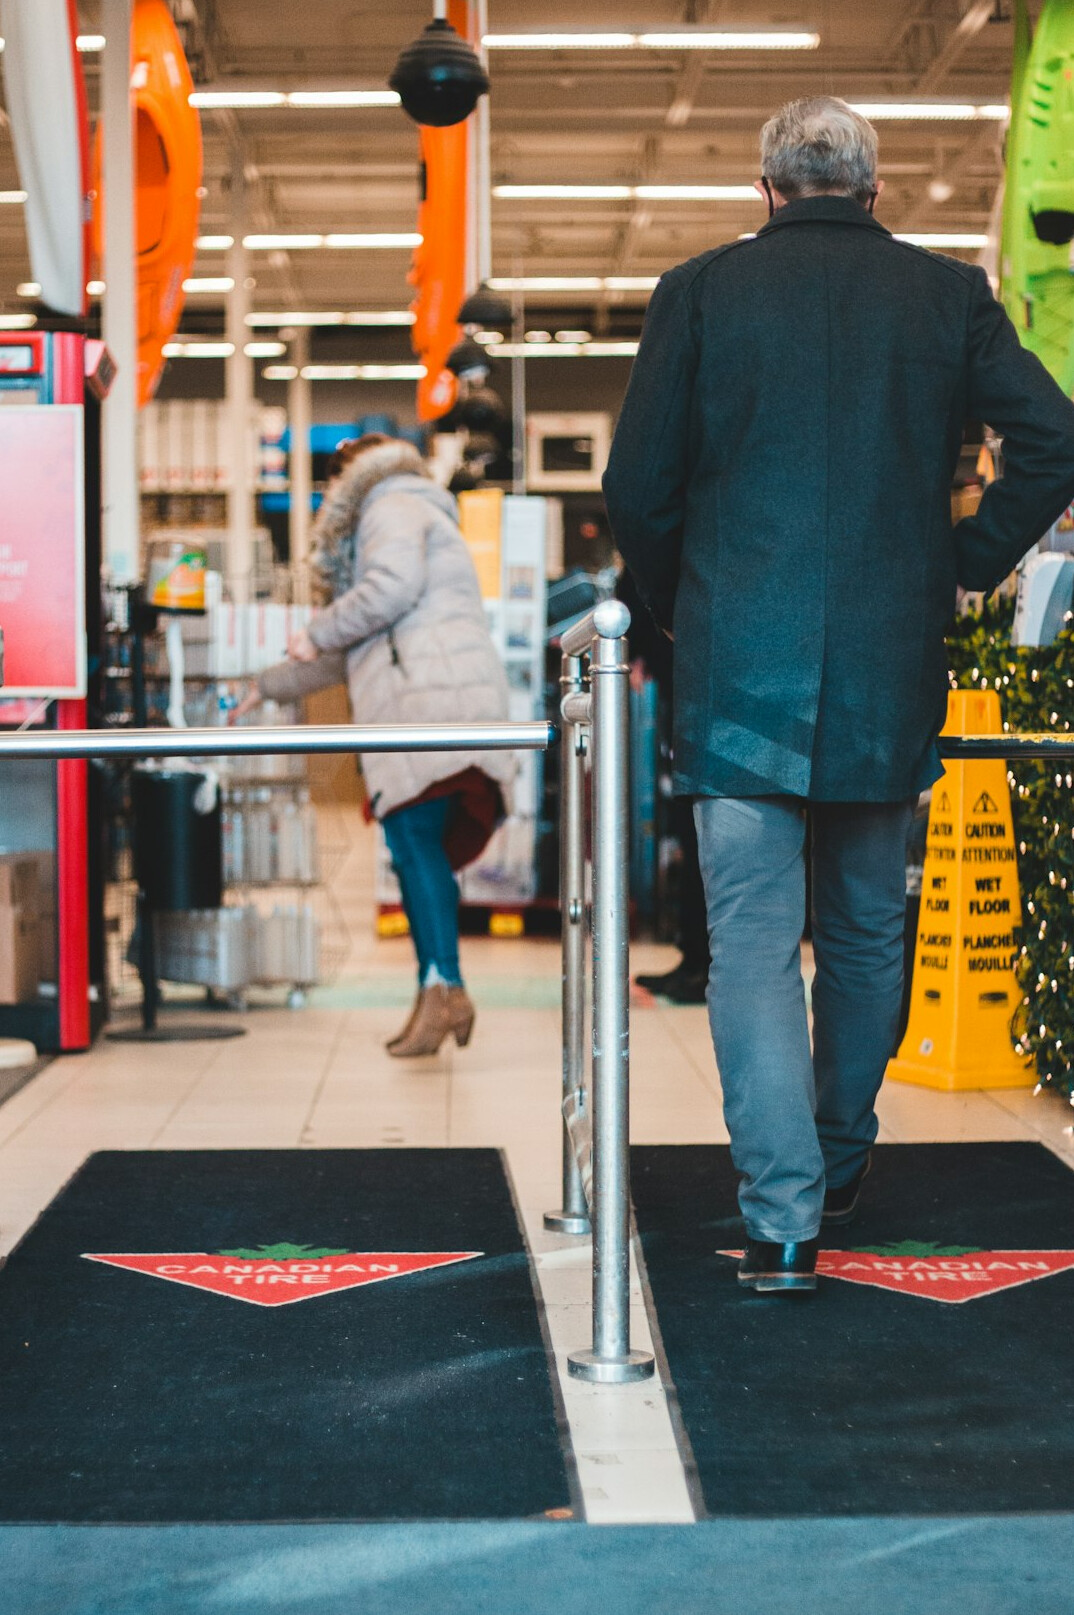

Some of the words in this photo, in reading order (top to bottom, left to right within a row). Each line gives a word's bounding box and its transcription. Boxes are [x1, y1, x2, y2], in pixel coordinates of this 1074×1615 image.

[965, 823, 1006, 839] CAUTION
[962, 847, 1016, 863] ATTENTION
[975, 877, 1002, 893] WET
[969, 900, 1010, 916] FLOOR
[156, 1264, 399, 1274] CANADIAN
[883, 1271, 993, 1282] TIRE
[226, 1274, 330, 1285] TIRE
